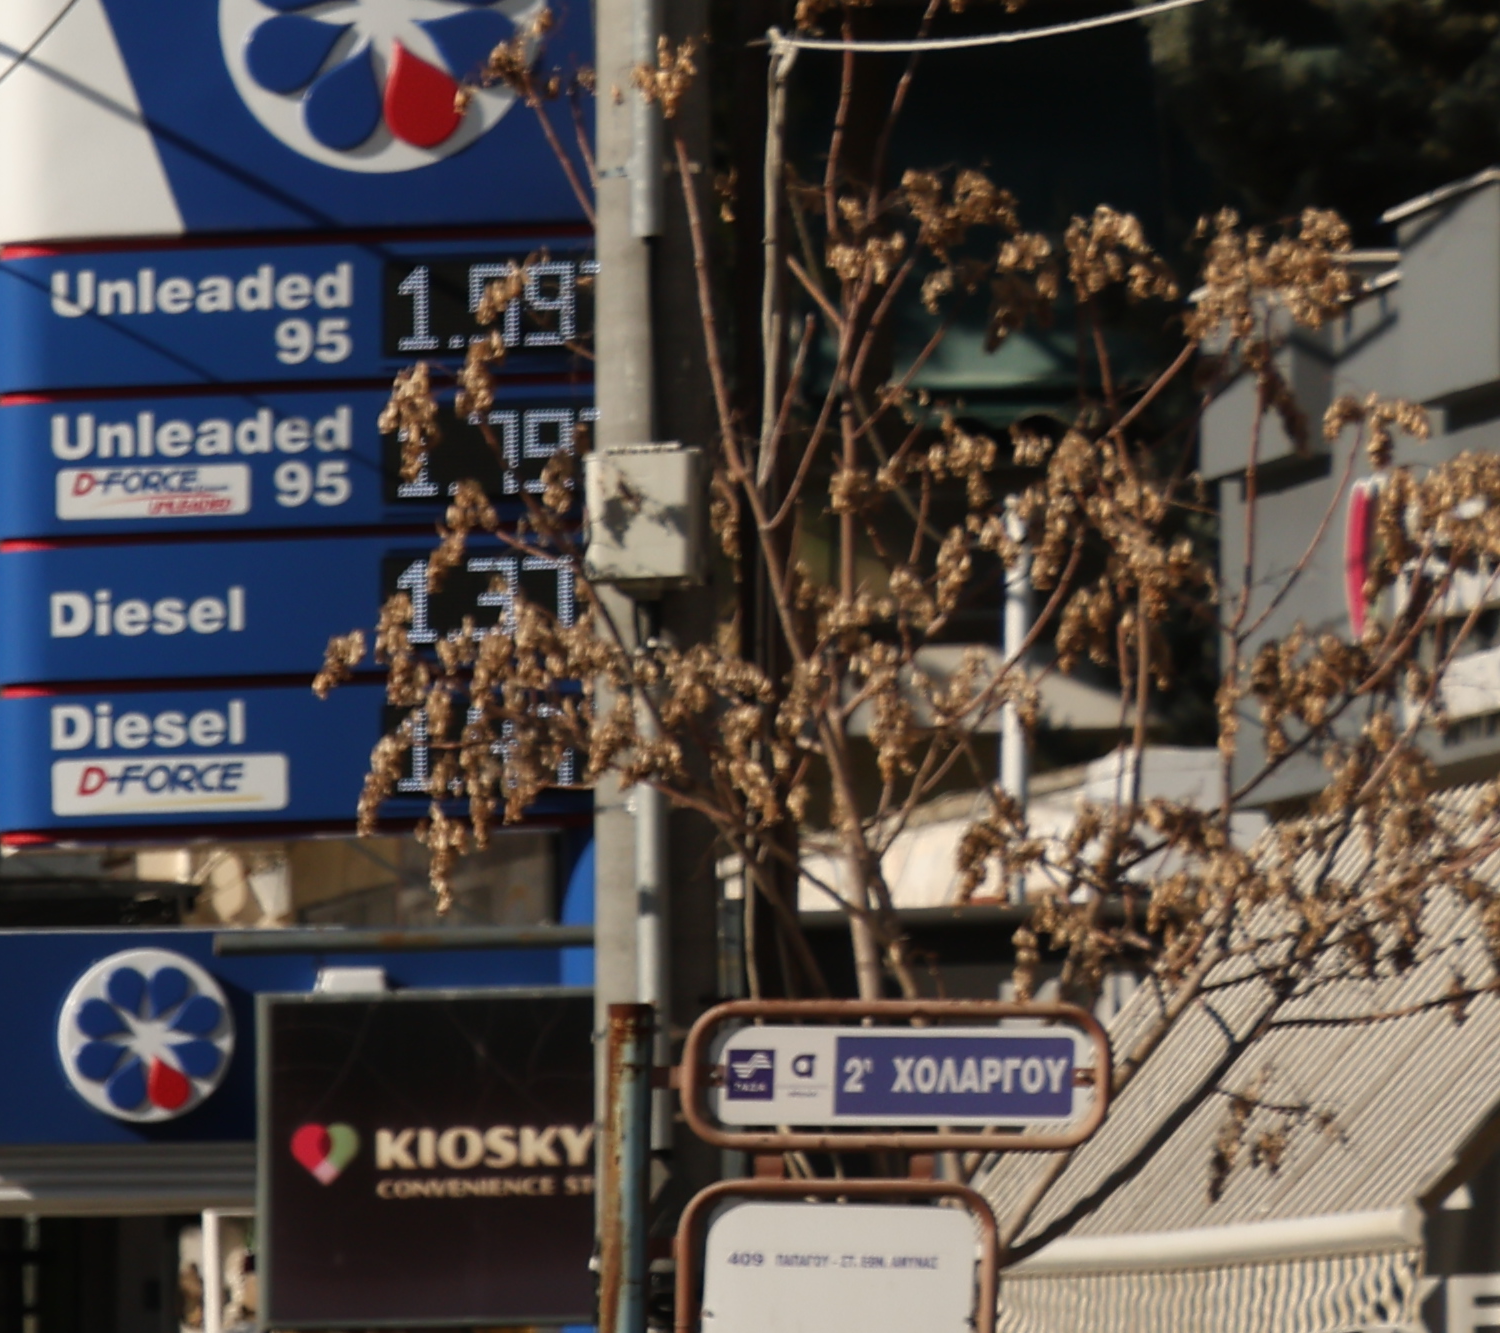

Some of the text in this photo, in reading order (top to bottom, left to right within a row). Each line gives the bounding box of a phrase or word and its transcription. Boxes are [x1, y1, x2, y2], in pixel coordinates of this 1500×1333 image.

[51, 262, 352, 318] Unleaded
[398, 261, 600, 351] 1.59
[275, 316, 351, 364] 95
[51, 406, 351, 461] Unleaded
[71, 469, 200, 497] D-FORCE
[274, 460, 351, 507] 95
[50, 585, 246, 637] Diesel
[50, 699, 246, 750] Diesel
[77, 762, 244, 796] D-FORCE
[890, 1056, 1068, 1094] ΧΟΛΑΡΓΟΥ
[375, 1177, 555, 1200] CONVENIENCE
[728, 1252, 764, 1267] 409
